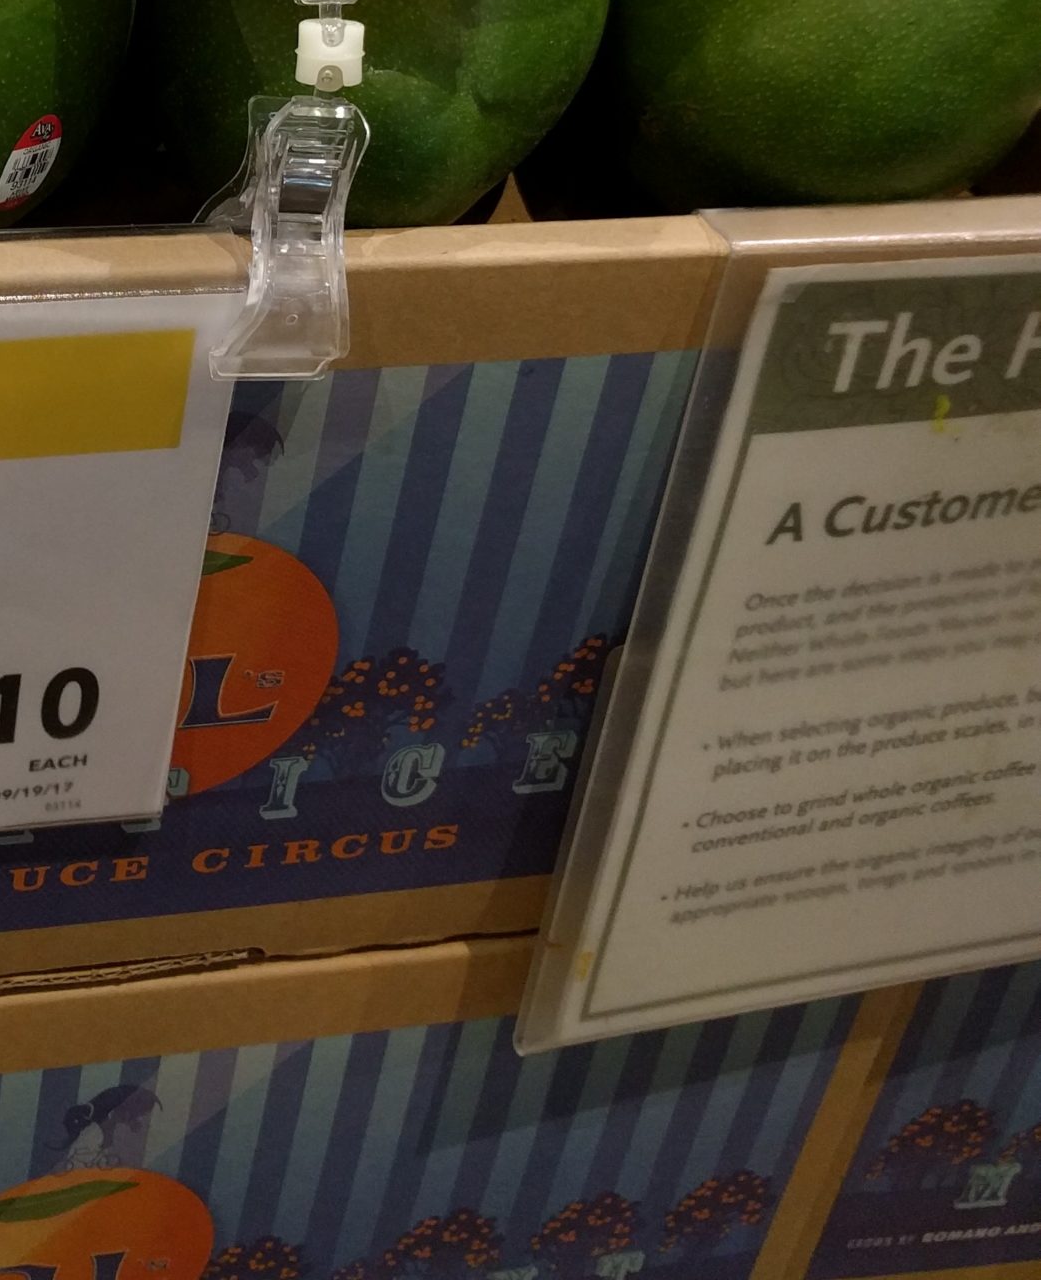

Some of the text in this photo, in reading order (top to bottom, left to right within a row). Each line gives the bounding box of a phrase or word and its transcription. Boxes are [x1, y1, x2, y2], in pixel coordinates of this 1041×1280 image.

[828, 312, 983, 393] The
[765, 502, 803, 546] A
[745, 592, 799, 611] Once
[716, 729, 773, 751] When
[778, 720, 861, 743] selecting
[865, 709, 937, 730] organic
[27, 754, 89, 773] EACH
[712, 754, 785, 782] placing
[788, 749, 803, 765] it
[806, 746, 832, 763] on
[837, 739, 868, 759] the
[870, 729, 950, 757] produce
[695, 805, 769, 828] Choose
[773, 802, 793, 817] to
[797, 793, 849, 819] grind
[852, 781, 907, 803] whole
[909, 772, 979, 797] organic
[191, 823, 461, 875] CIRCUS
[691, 819, 815, 854] conventional
[818, 813, 855, 833] and
[858, 802, 927, 827] organic
[673, 881, 720, 902] Help
[724, 878, 748, 892] us
